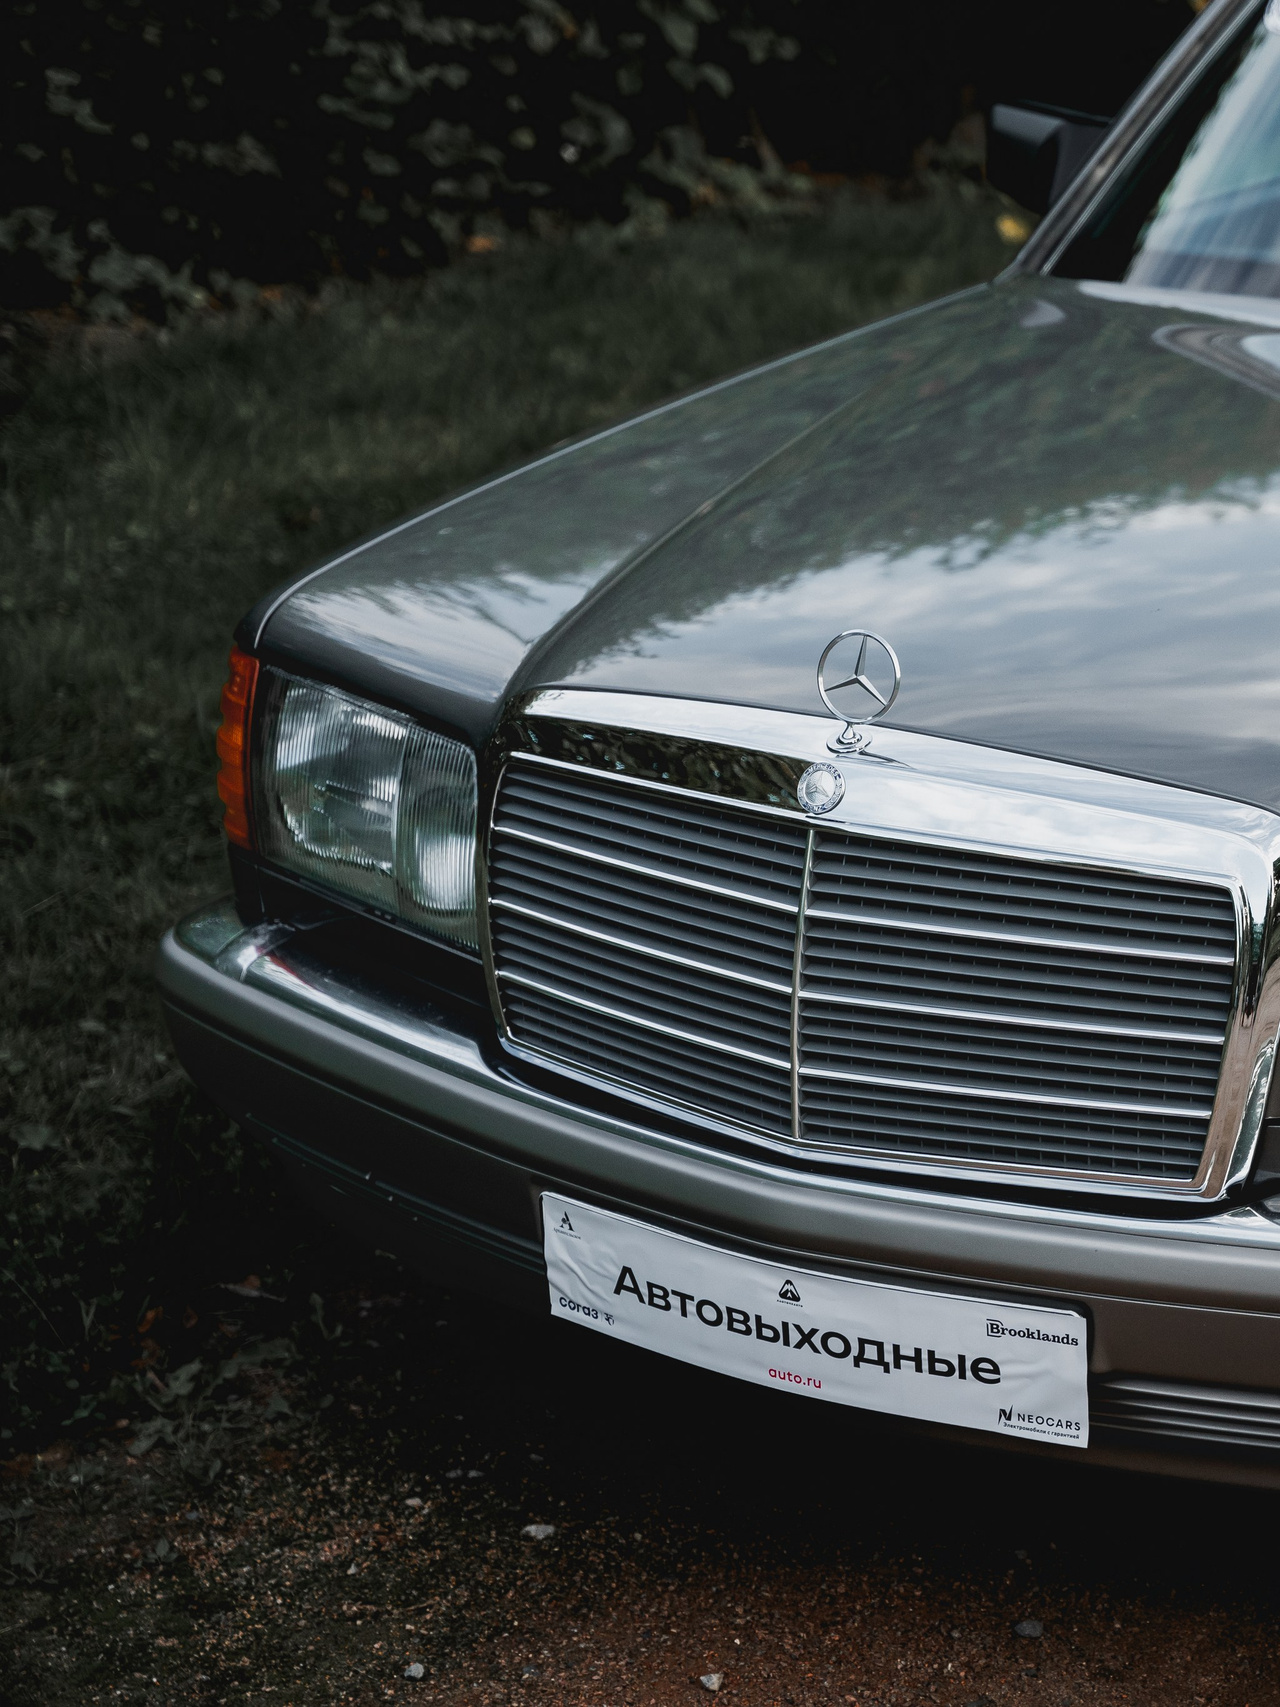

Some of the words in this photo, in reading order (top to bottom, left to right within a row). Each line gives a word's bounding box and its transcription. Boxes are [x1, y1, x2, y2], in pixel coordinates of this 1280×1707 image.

[613, 1265, 1001, 1385] Автовыходные
[987, 1319, 1079, 1346] Brooklands
[768, 1368, 822, 1389] auto.ru
[1003, 1422, 1047, 1434] Электромобили
[1051, 1431, 1080, 1439] гарантией
[1017, 1412, 1081, 1431] NEOCARS
